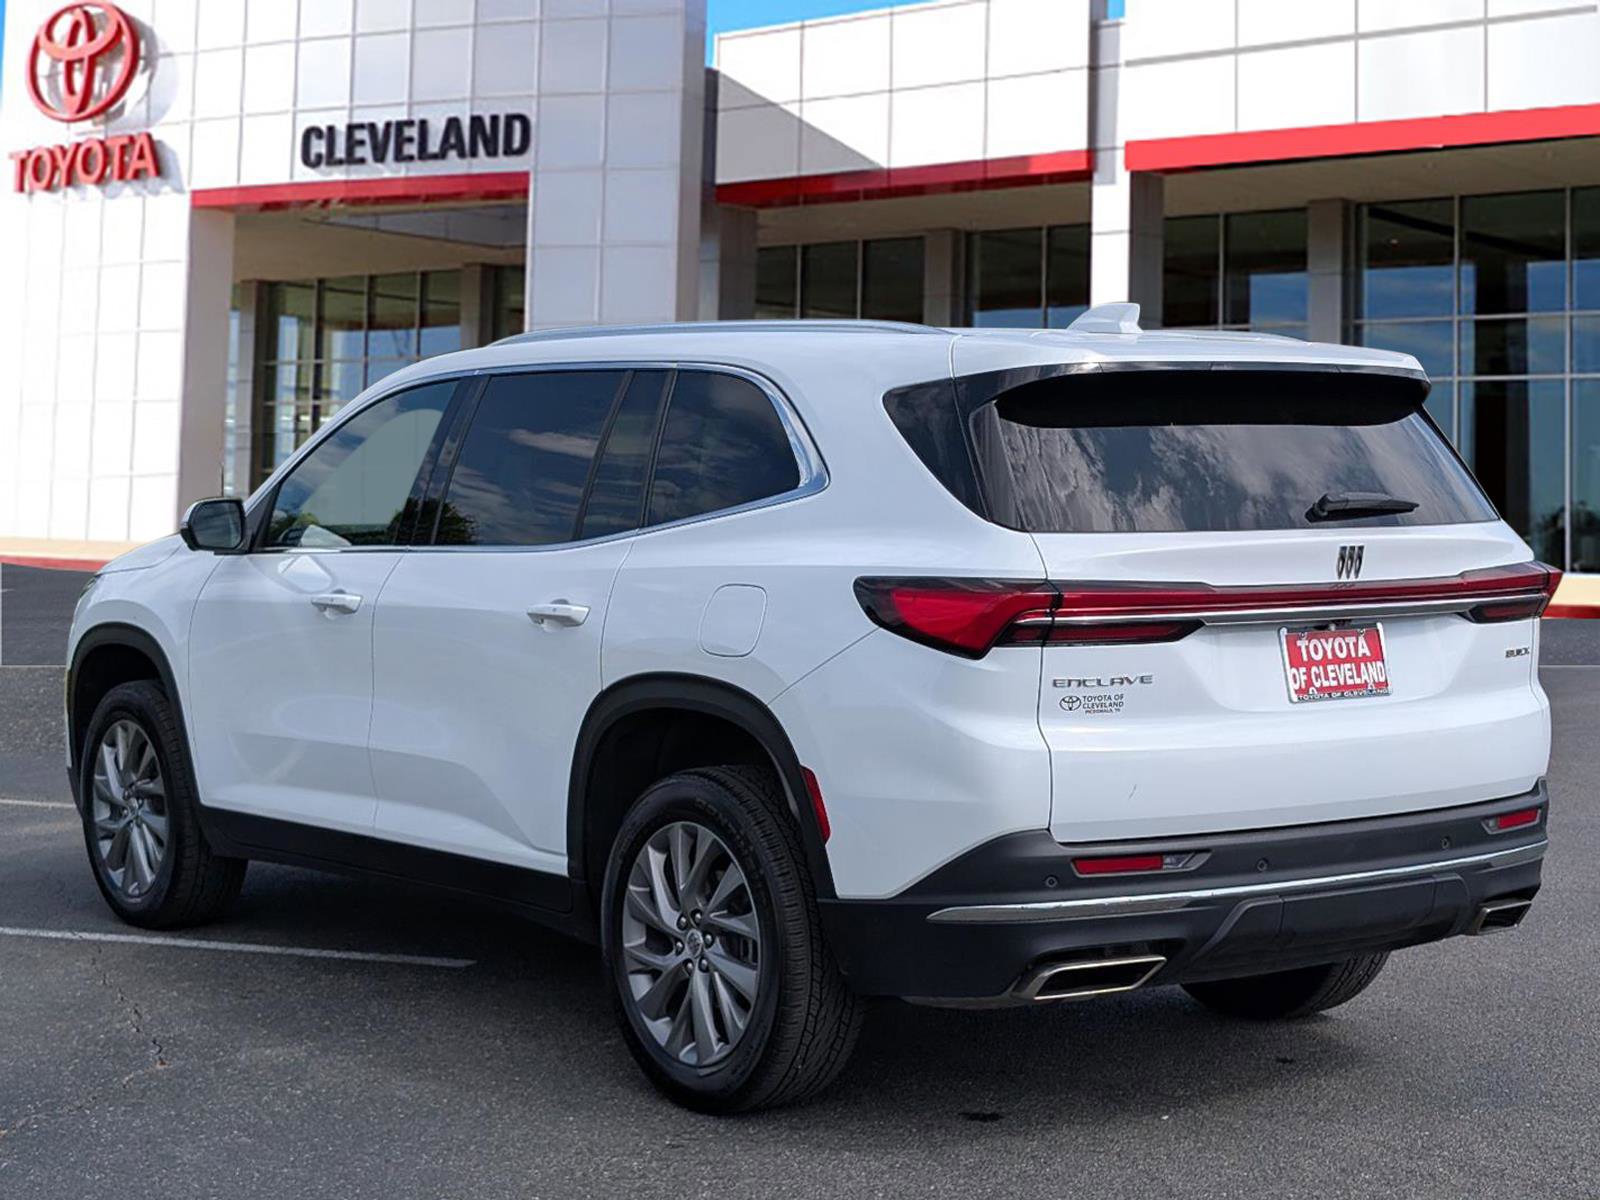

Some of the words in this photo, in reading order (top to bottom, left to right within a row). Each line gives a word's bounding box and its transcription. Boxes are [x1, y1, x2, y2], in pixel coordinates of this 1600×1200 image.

[301, 113, 531, 169] CLEVELAND
[8, 132, 161, 195] TOYOTA
[1296, 634, 1371, 662] TOYOTA
[1052, 674, 1153, 688] ENCLAVE
[1290, 666, 1308, 691] OF
[1310, 660, 1386, 688] CLEVELAND
[1082, 694, 1112, 703] TOYOTA
[1113, 693, 1124, 701] OF
[1082, 701, 1124, 710] CLEVELAND
